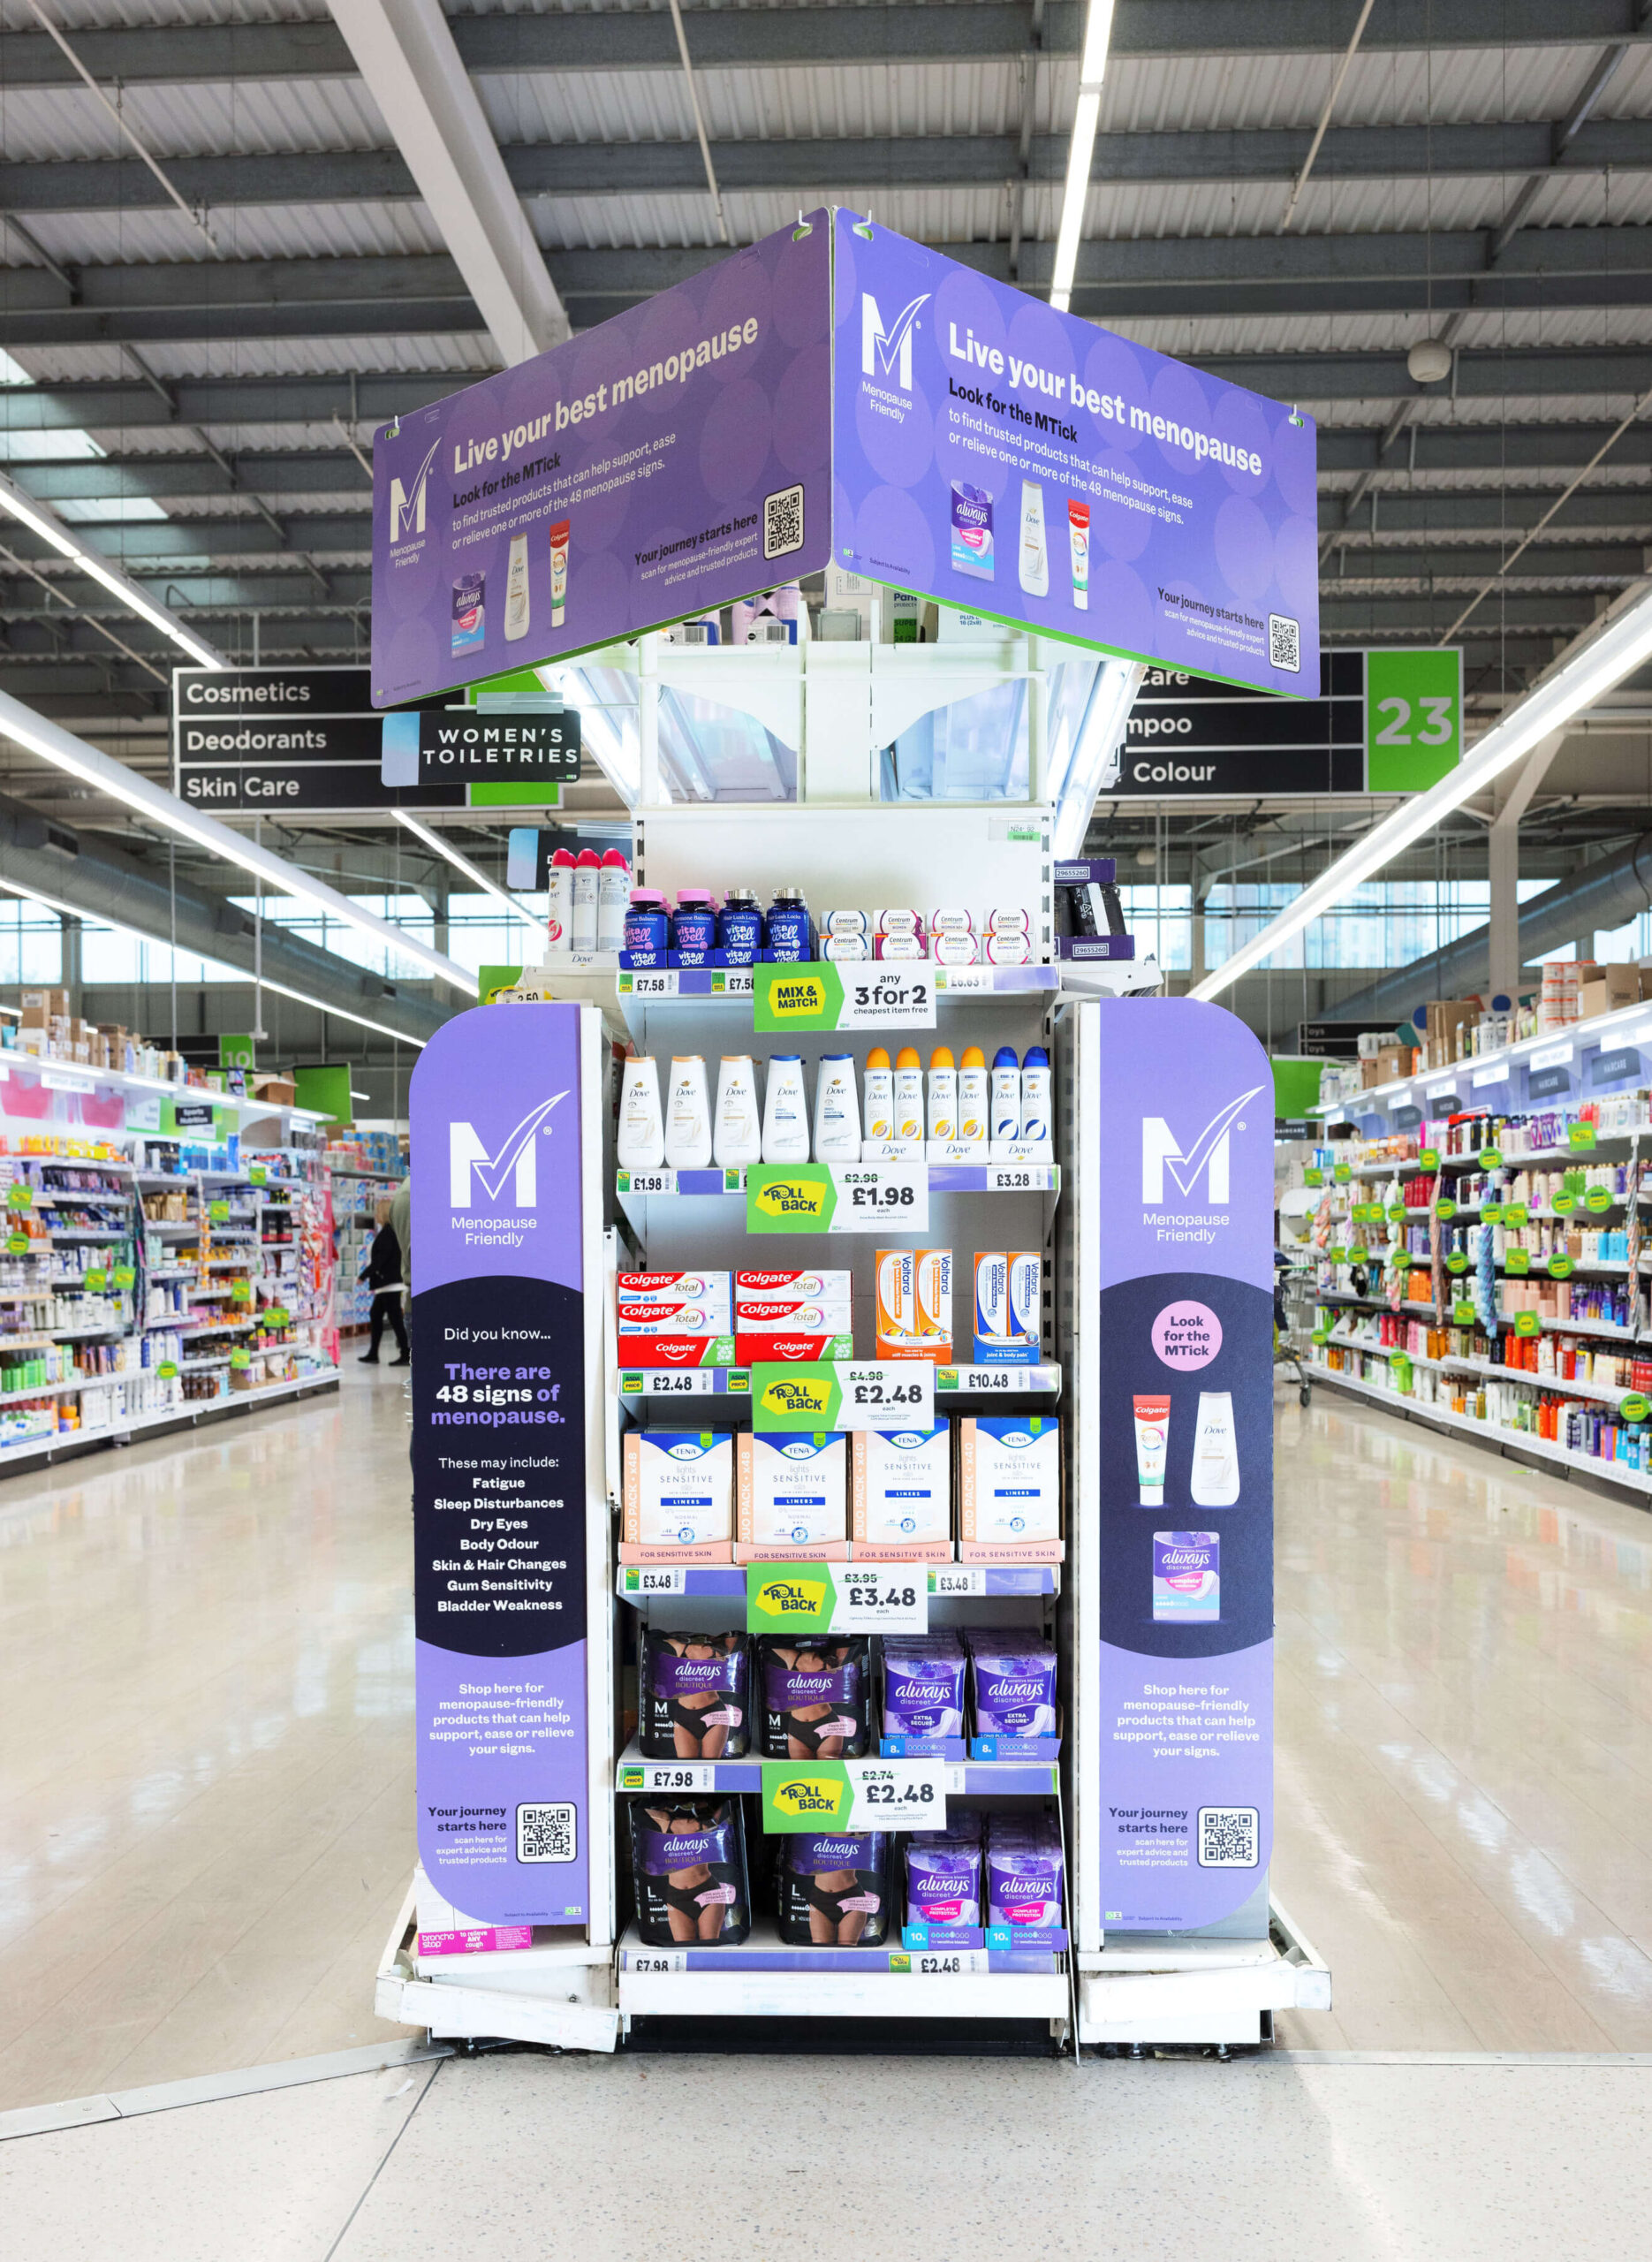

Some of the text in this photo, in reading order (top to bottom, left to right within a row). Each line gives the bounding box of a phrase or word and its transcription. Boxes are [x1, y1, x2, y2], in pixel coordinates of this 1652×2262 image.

[454, 317, 758, 474] Live your best menopause
[862, 381, 913, 410] Menopause
[950, 323, 1262, 476] Live your best menopause
[869, 399, 905, 424] Friendly
[949, 377, 1078, 443] Look for the MTick
[949, 407, 1193, 509] to find trusted products that can help support, ease
[452, 452, 561, 508] Look for the MTick
[390, 538, 426, 558] Menopause
[396, 552, 419, 568] Friendly
[1157, 587, 1264, 630] Your journey starts here
[186, 682, 310, 703] Cosmetics
[1375, 697, 1452, 745] 23
[187, 730, 327, 750] Deodorants
[438, 728, 563, 744] WOMEN'S
[423, 749, 578, 764] TOILETRIES
[1133, 762, 1216, 782] Colour
[187, 777, 299, 797] Skin Care
[637, 979, 664, 991] £7.58
[880, 975, 901, 984] any
[777, 985, 816, 998] MIX &
[855, 985, 927, 1006] 3 for 2
[629, 1089, 650, 1097] Dove
[179, 1115, 208, 1124] Nutrition
[945, 1144, 970, 1154] Dove
[634, 1177, 662, 1191] £1.98
[845, 1174, 878, 1183] £2.98
[997, 1174, 1029, 1187] £3.28
[853, 1188, 914, 1205] £1.98
[451, 1217, 537, 1231] Menopause
[1143, 1213, 1230, 1227] Menopause
[465, 1232, 524, 1248] Friendly
[1156, 1229, 1216, 1244] Friendly
[621, 1274, 698, 1292] Colgate Total
[900, 1256, 912, 1295] Voltarol
[1170, 1316, 1203, 1327] Look
[444, 1327, 550, 1342] Did you know...
[1163, 1330, 1210, 1341] for the
[655, 1343, 696, 1354] Colgate
[1164, 1345, 1209, 1356] MTick
[444, 1363, 551, 1380] There are
[653, 1377, 692, 1391] £2.48
[968, 1374, 1008, 1388] £10.48
[436, 1384, 560, 1406] 48 signs of
[855, 1385, 922, 1403] £2.48
[431, 1410, 565, 1428] menopause.
[438, 1456, 559, 1470] These may include:
[473, 1477, 525, 1491] Fatigue
[434, 1498, 564, 1511] Sleep Disturbances
[471, 1518, 528, 1531] Dry Eyes
[460, 1538, 539, 1552] Body Odour
[432, 1559, 566, 1571] Skin & Hair Changes
[447, 1579, 552, 1591] Gum Sensitivity
[643, 1575, 671, 1589] £3.48
[850, 1588, 916, 1606] £3.48
[437, 1599, 563, 1612] Bladder Weakness
[675, 1661, 721, 1680] always
[459, 1683, 544, 1696] Shop here for
[895, 1681, 951, 1704] always
[439, 1697, 564, 1711] menopause-friendly
[433, 1714, 489, 1727] products
[492, 1713, 518, 1724] that
[544, 1712, 570, 1726] help
[429, 1729, 482, 1742] support,
[531, 1727, 574, 1738] relieve
[469, 1743, 535, 1756] your signs.
[654, 1772, 693, 1787] £7.98
[867, 1784, 934, 1803] £2.48
[428, 1806, 506, 1818] Your journey
[437, 1820, 506, 1832] starts here
[436, 1847, 462, 1856] expert
[470, 1856, 507, 1865] products
